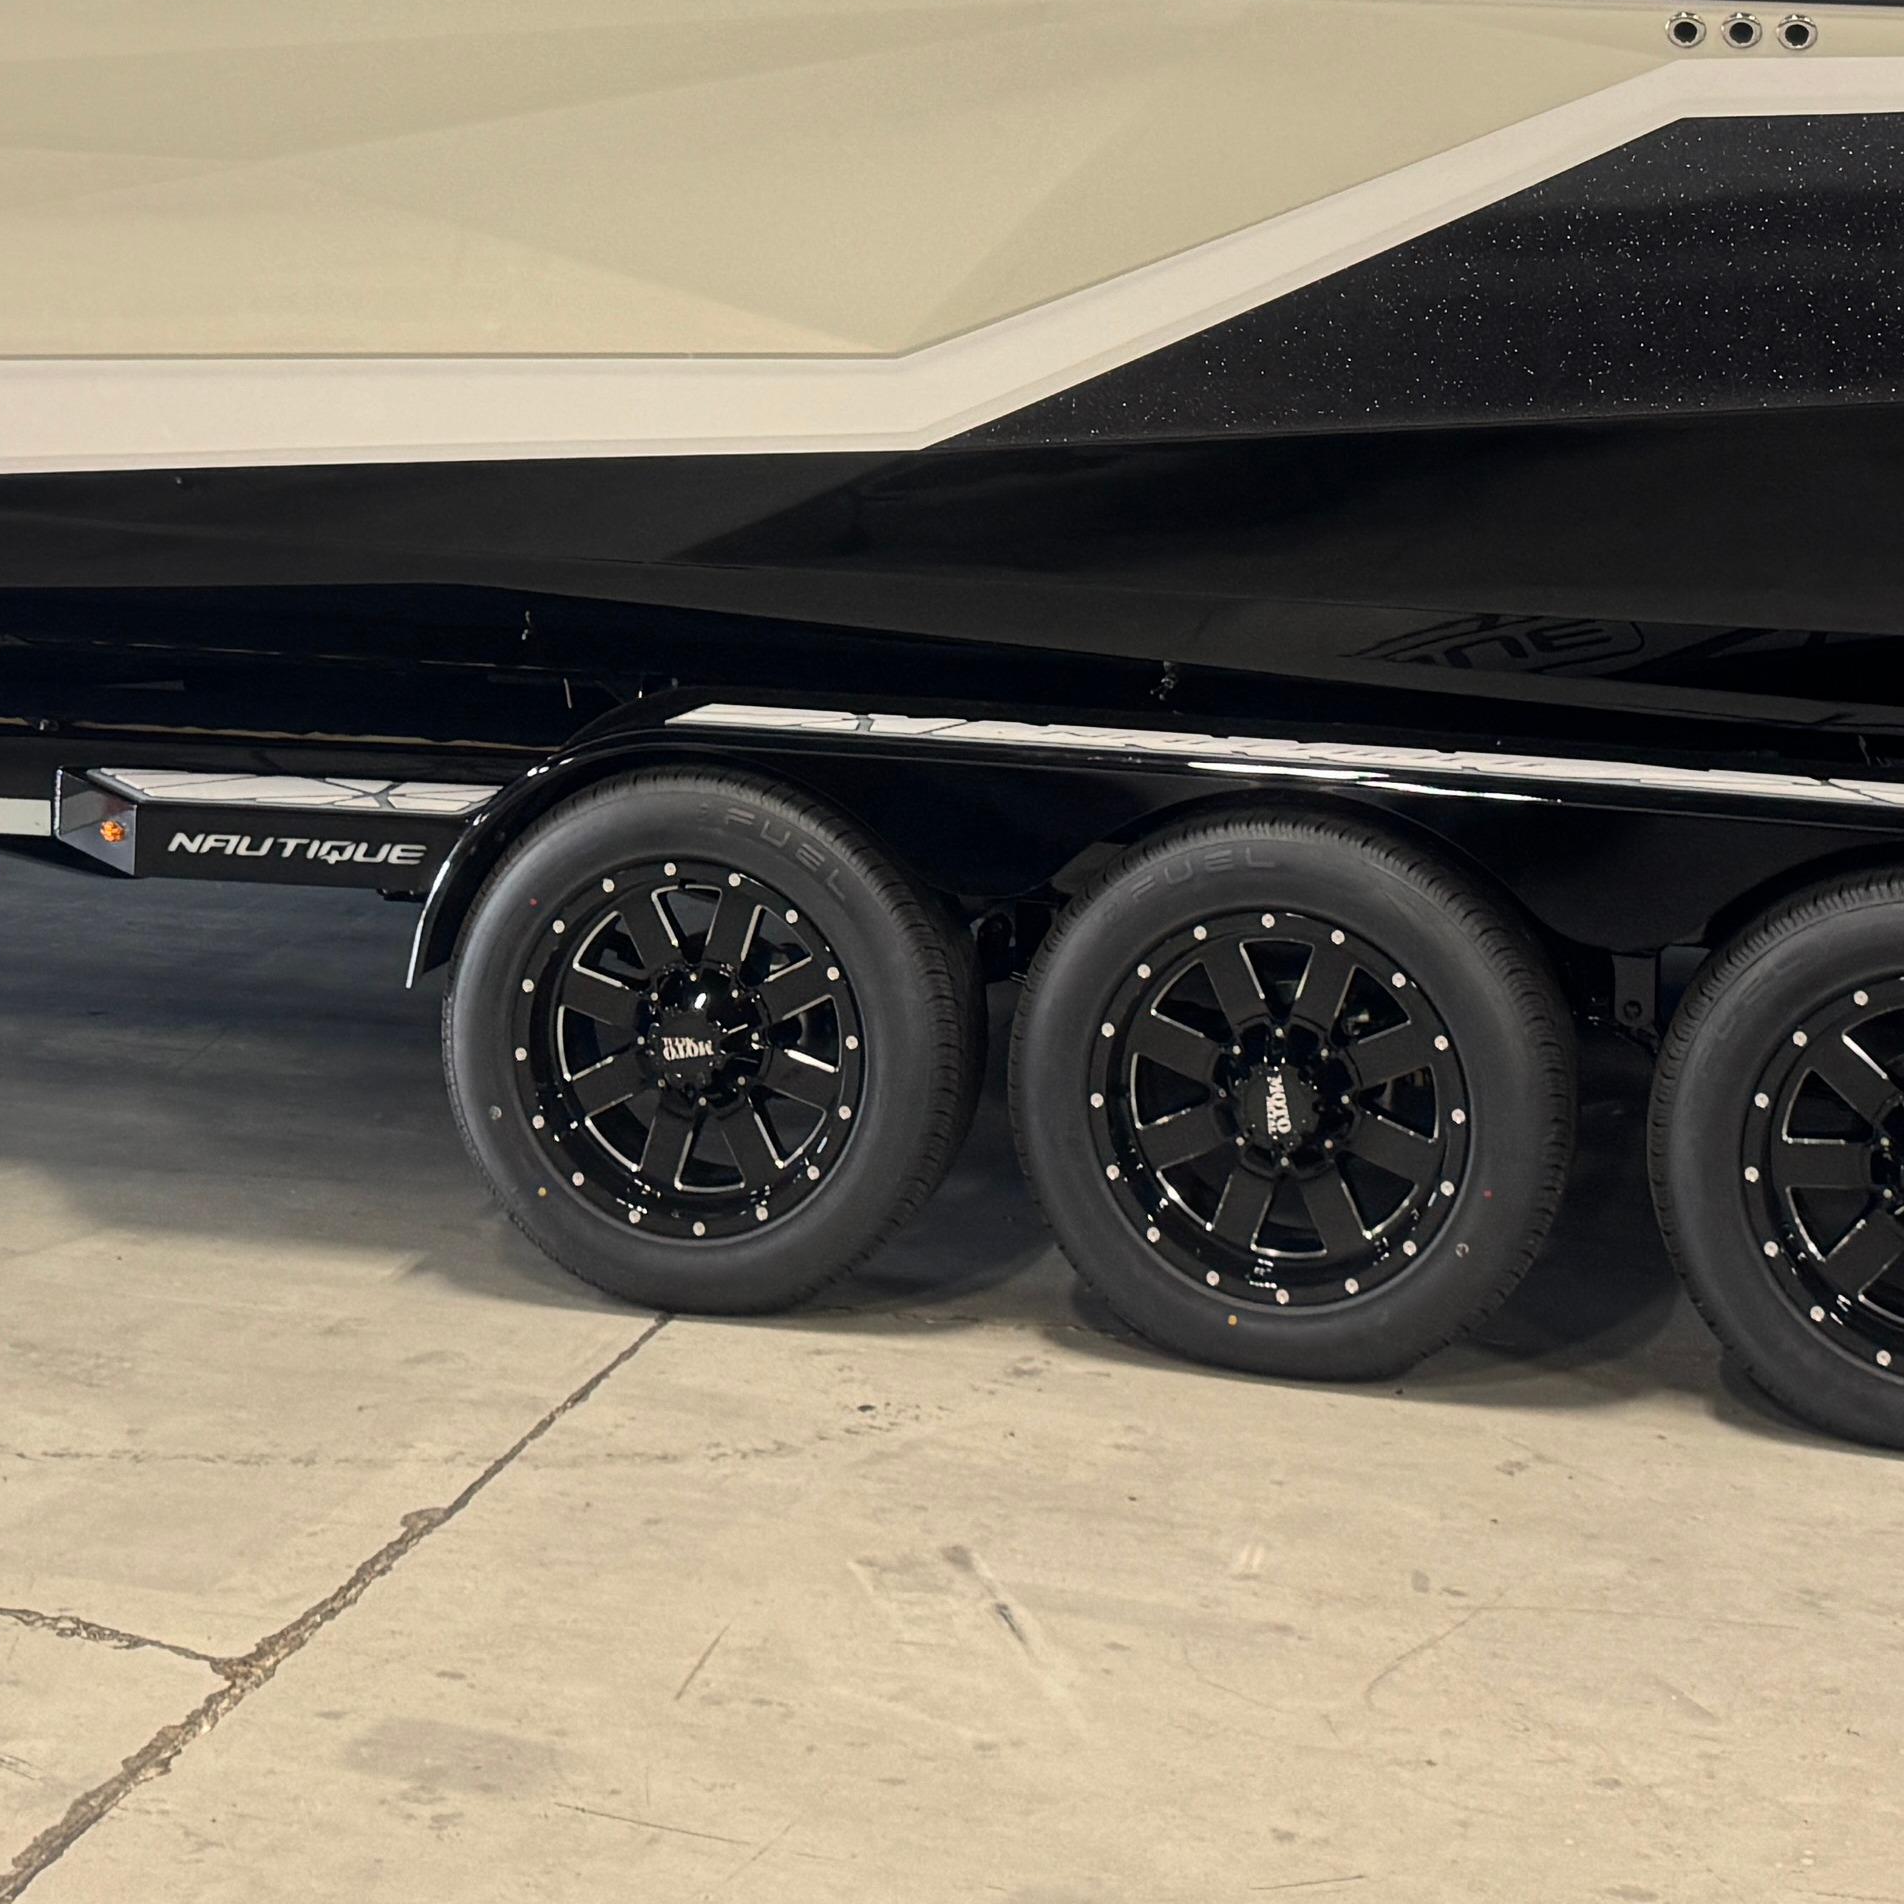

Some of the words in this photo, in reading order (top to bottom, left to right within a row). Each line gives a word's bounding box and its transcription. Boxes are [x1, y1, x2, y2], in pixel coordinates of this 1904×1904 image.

[167, 831, 428, 865] NAUTIQUE
[725, 806, 848, 902] FUEL
[1130, 847, 1277, 900] FUEL
